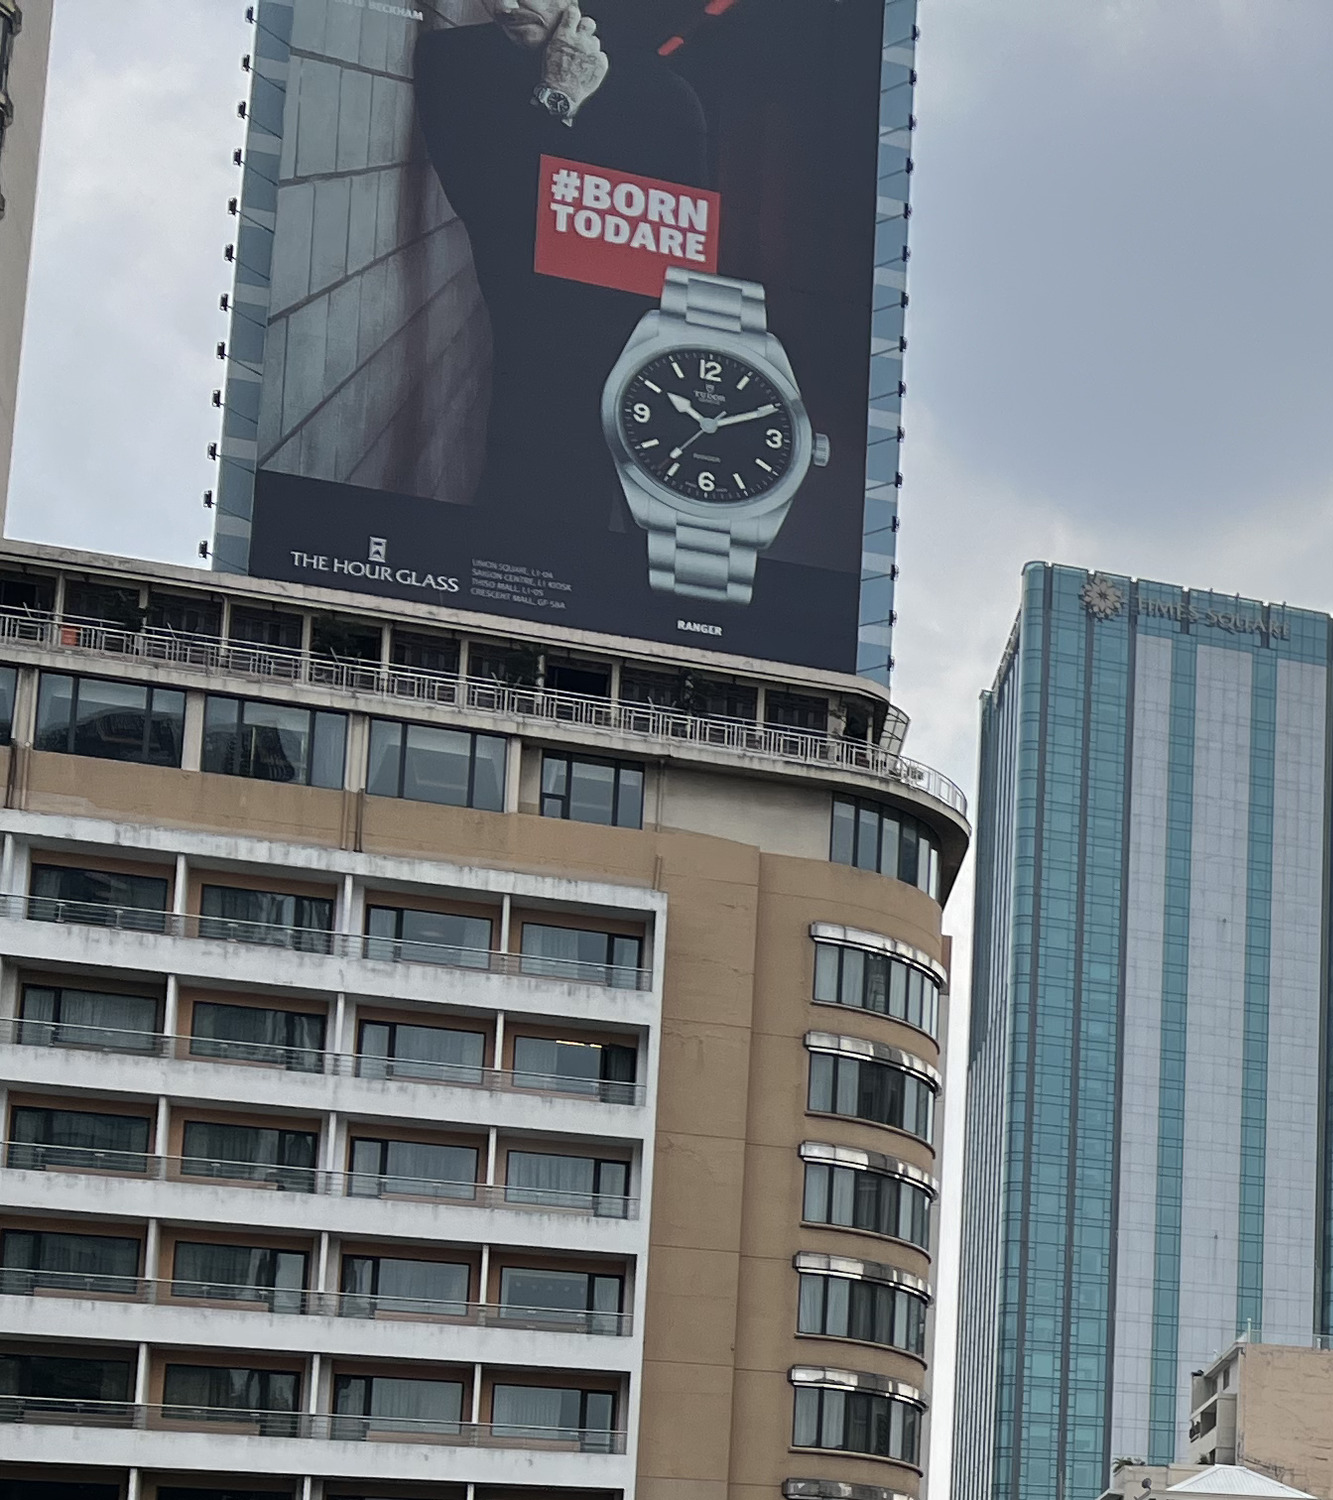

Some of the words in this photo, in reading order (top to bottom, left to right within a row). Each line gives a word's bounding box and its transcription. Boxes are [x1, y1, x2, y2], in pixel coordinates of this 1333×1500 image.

[368, 2, 424, 21] BECKHAM
[551, 168, 708, 231] #BORN
[550, 202, 706, 262] TODARE
[700, 359, 722, 382] 12
[633, 403, 651, 423] 9
[765, 428, 783, 449] 3
[698, 471, 715, 491] 6
[290, 551, 329, 571] THE
[333, 558, 393, 582] HOUR
[395, 569, 460, 593] GLASS
[471, 568, 503, 580] SAIGON
[677, 619, 722, 636] RANGER
[1132, 594, 1199, 623] TIMES
[1204, 608, 1291, 640] SQUARE
